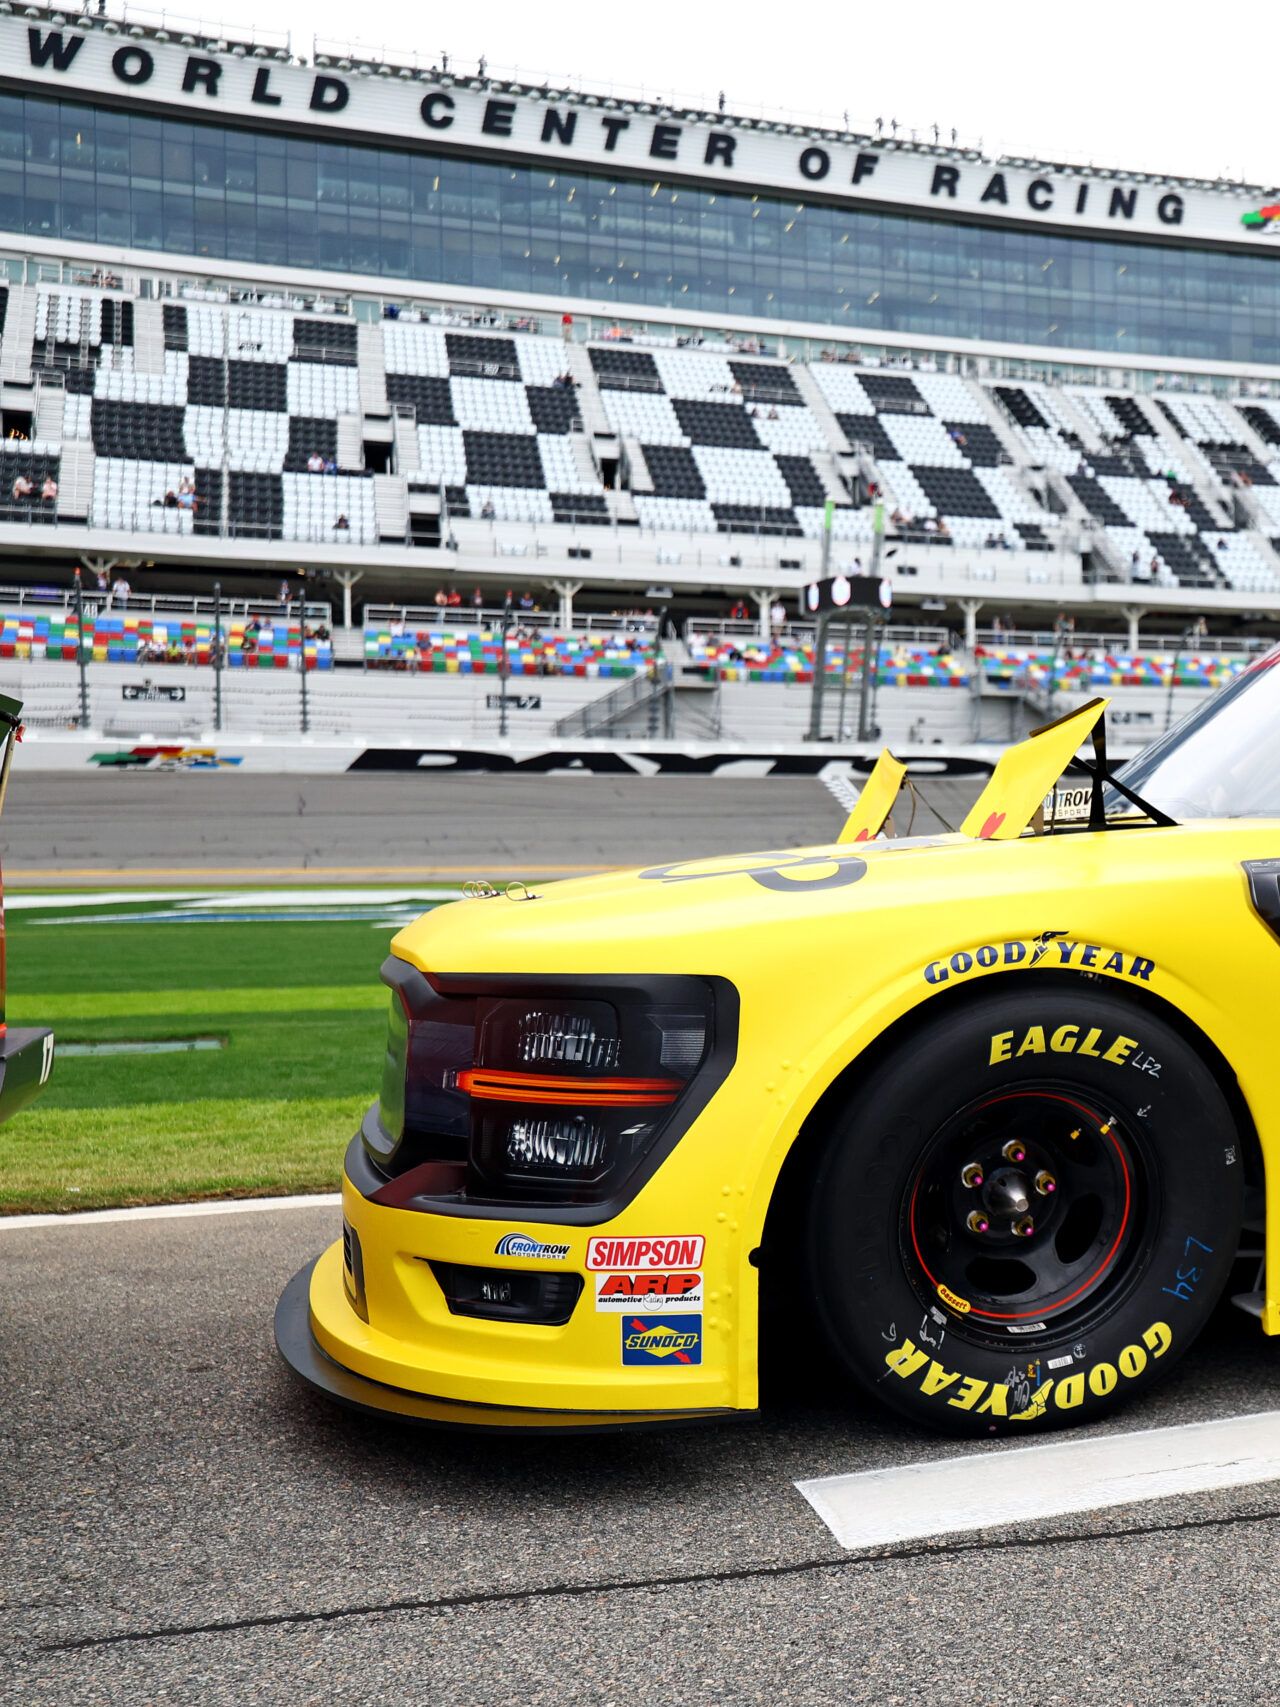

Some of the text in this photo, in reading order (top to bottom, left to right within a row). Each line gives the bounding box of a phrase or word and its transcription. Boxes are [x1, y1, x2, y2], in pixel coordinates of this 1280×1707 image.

[28, 28, 1185, 225] WORLD CENTER OF RACING
[989, 1024, 1139, 1066] EAGLE
[592, 1239, 698, 1267] SIMPSON
[598, 1274, 702, 1295] ARP
[598, 1295, 643, 1303] automotive
[665, 1294, 701, 1304] products
[940, 1287, 968, 1310] Bassett
[628, 1334, 697, 1349] SUNOCO
